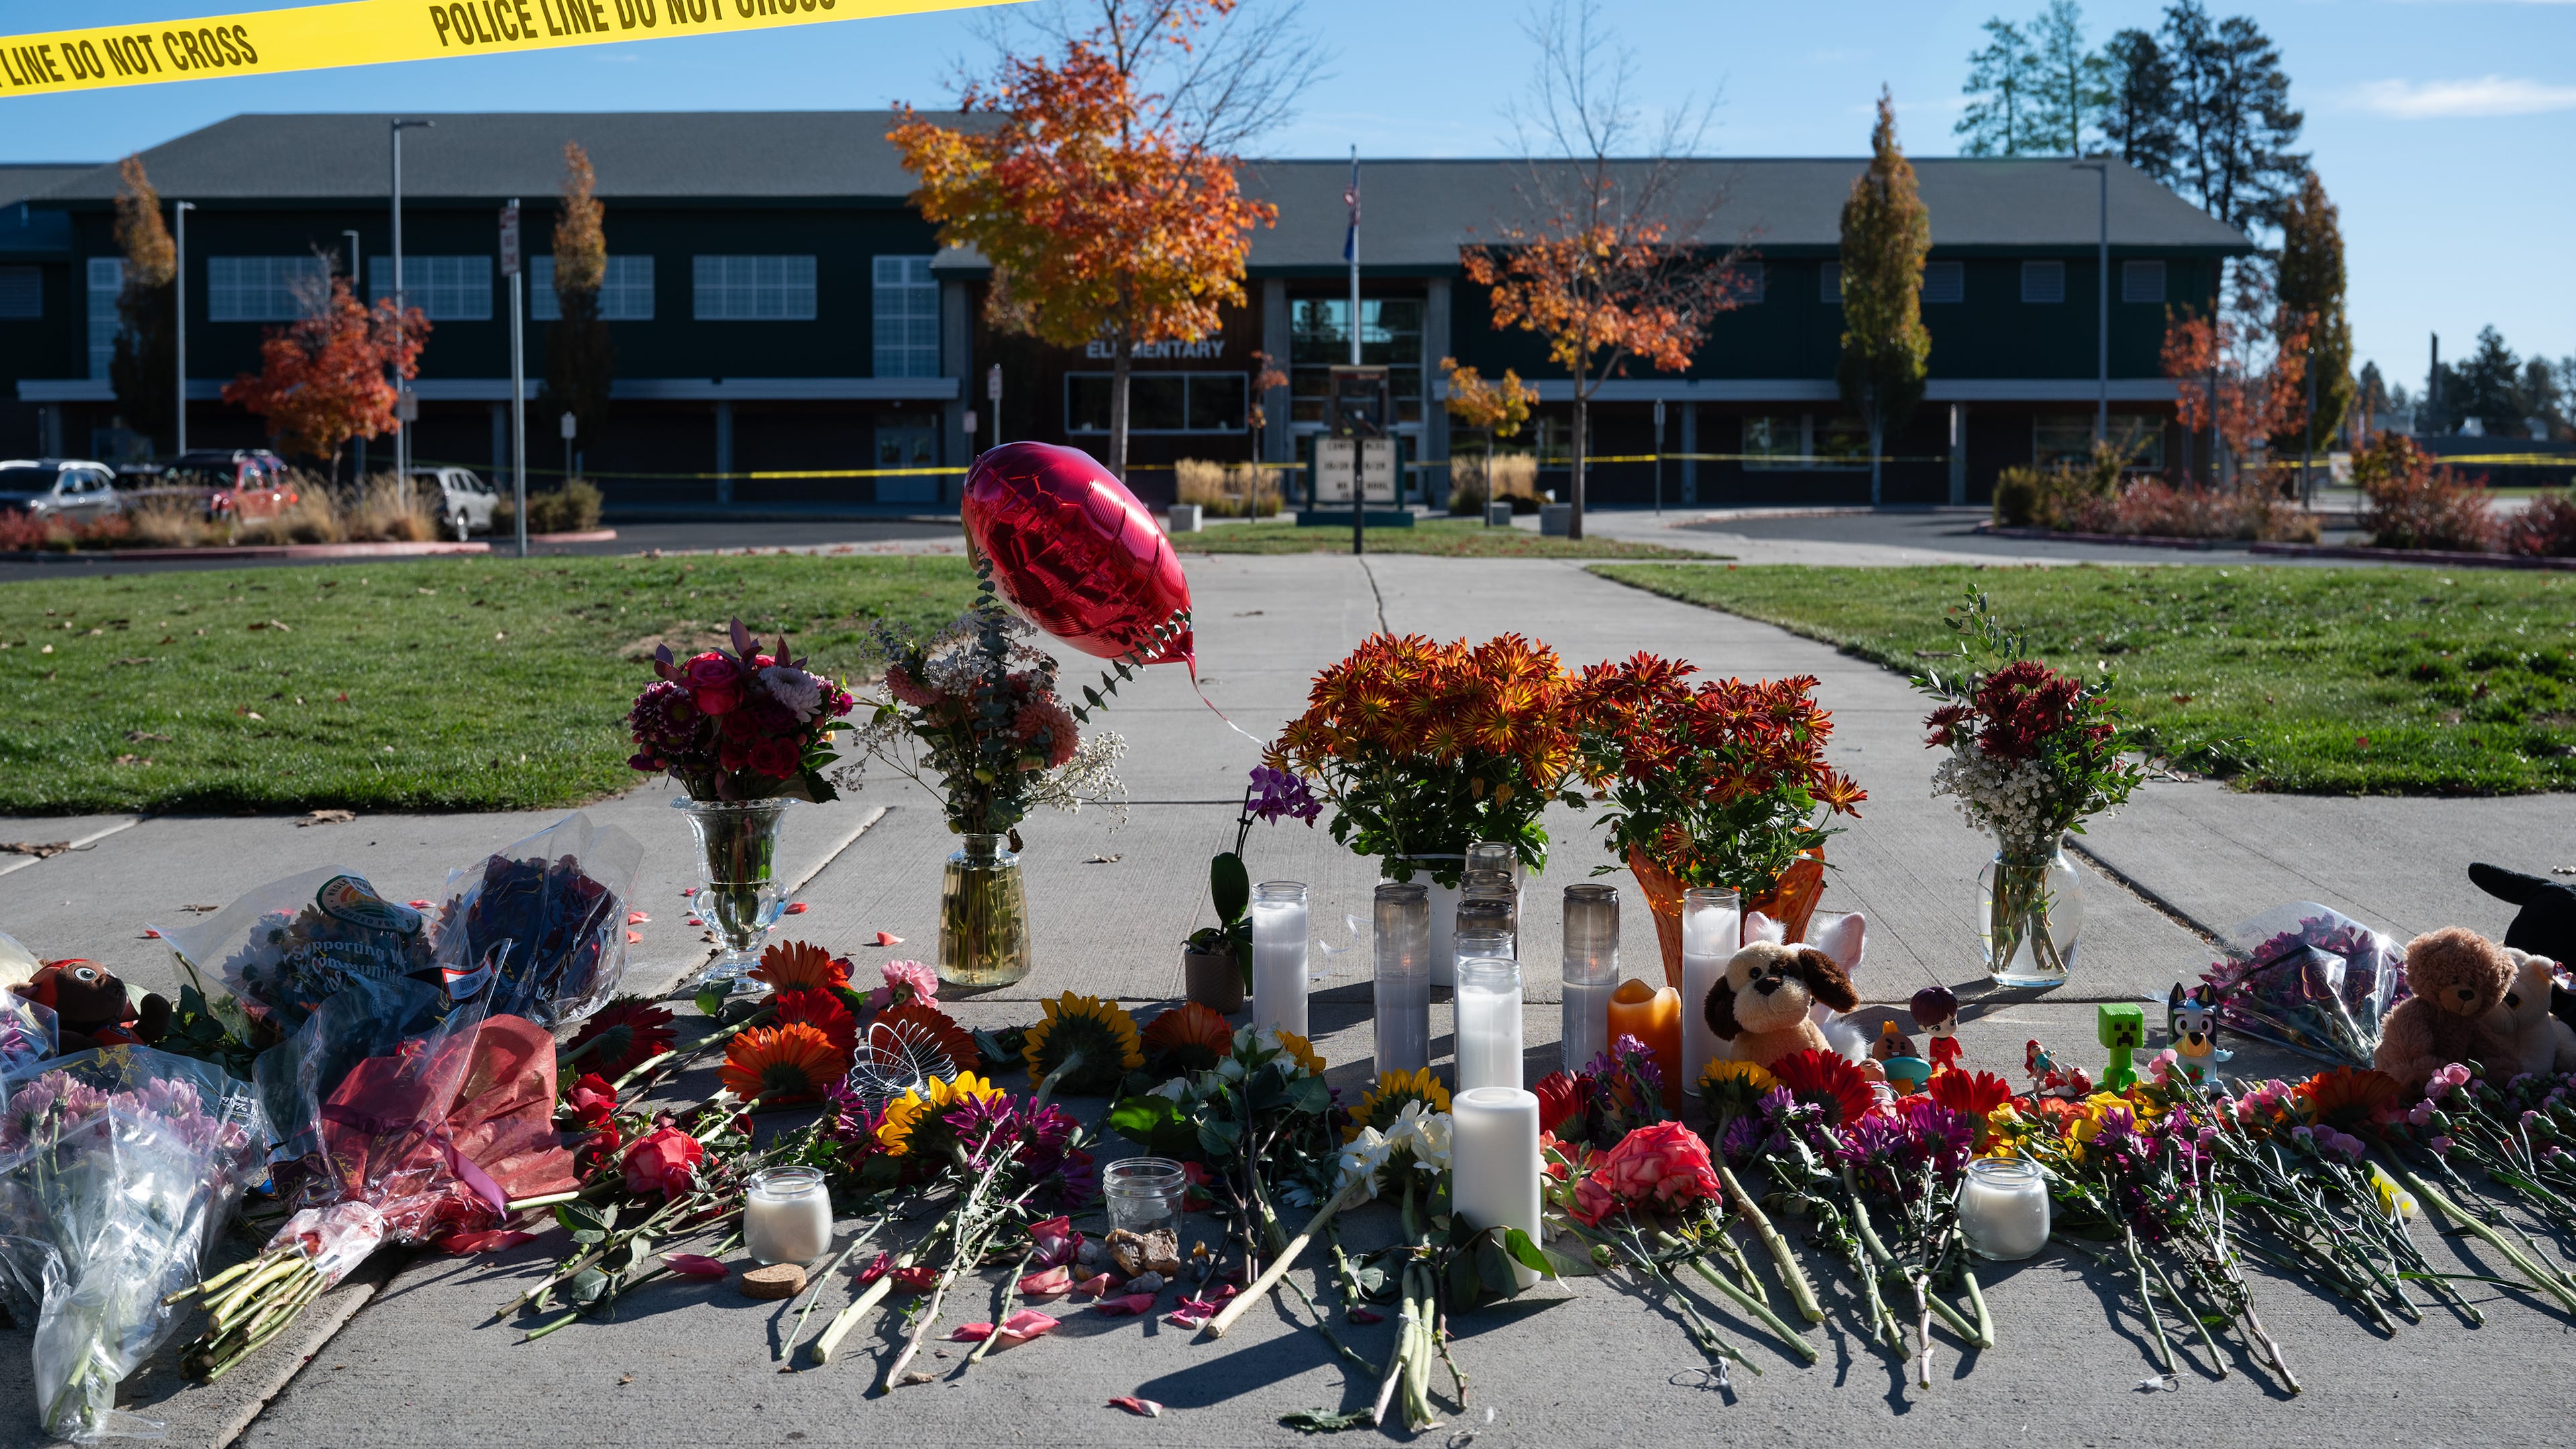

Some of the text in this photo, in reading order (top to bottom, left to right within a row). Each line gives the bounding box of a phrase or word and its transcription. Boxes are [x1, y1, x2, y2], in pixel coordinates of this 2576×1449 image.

[429, 0, 539, 46] POLICE
[541, 0, 610, 36] LINE
[0, 25, 258, 87] LINE DO NOT CROSS
[1085, 339, 1226, 359] ELMENTARY
[327, 879, 350, 897] WHOLE
[331, 905, 374, 924] SOURCED
[291, 941, 384, 961] Supporting
